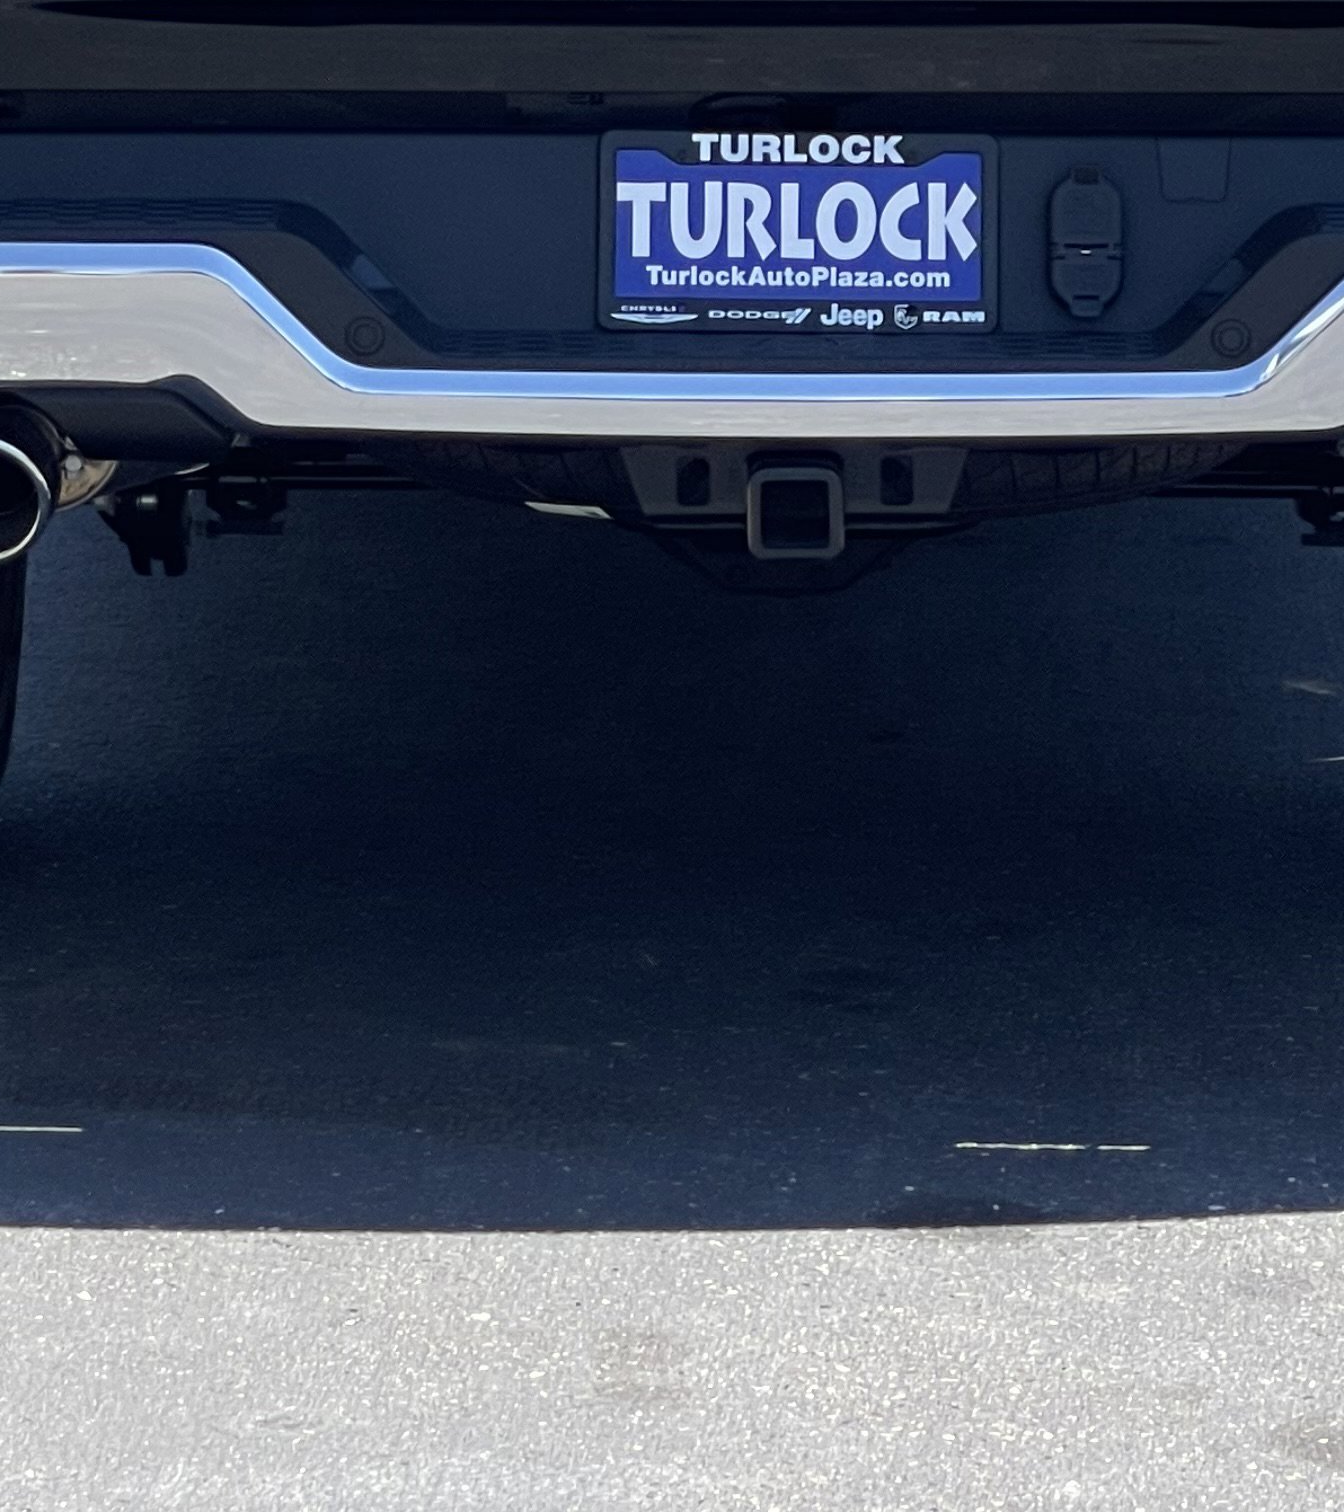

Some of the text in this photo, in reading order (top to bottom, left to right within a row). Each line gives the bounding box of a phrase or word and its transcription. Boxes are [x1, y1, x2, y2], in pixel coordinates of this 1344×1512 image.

[692, 133, 904, 164] TURLOCK
[617, 181, 978, 262] TURLOCK
[646, 265, 950, 289] TurlockAutoPlaza.com
[820, 303, 884, 330] Jeep
[923, 310, 986, 323] RAM
